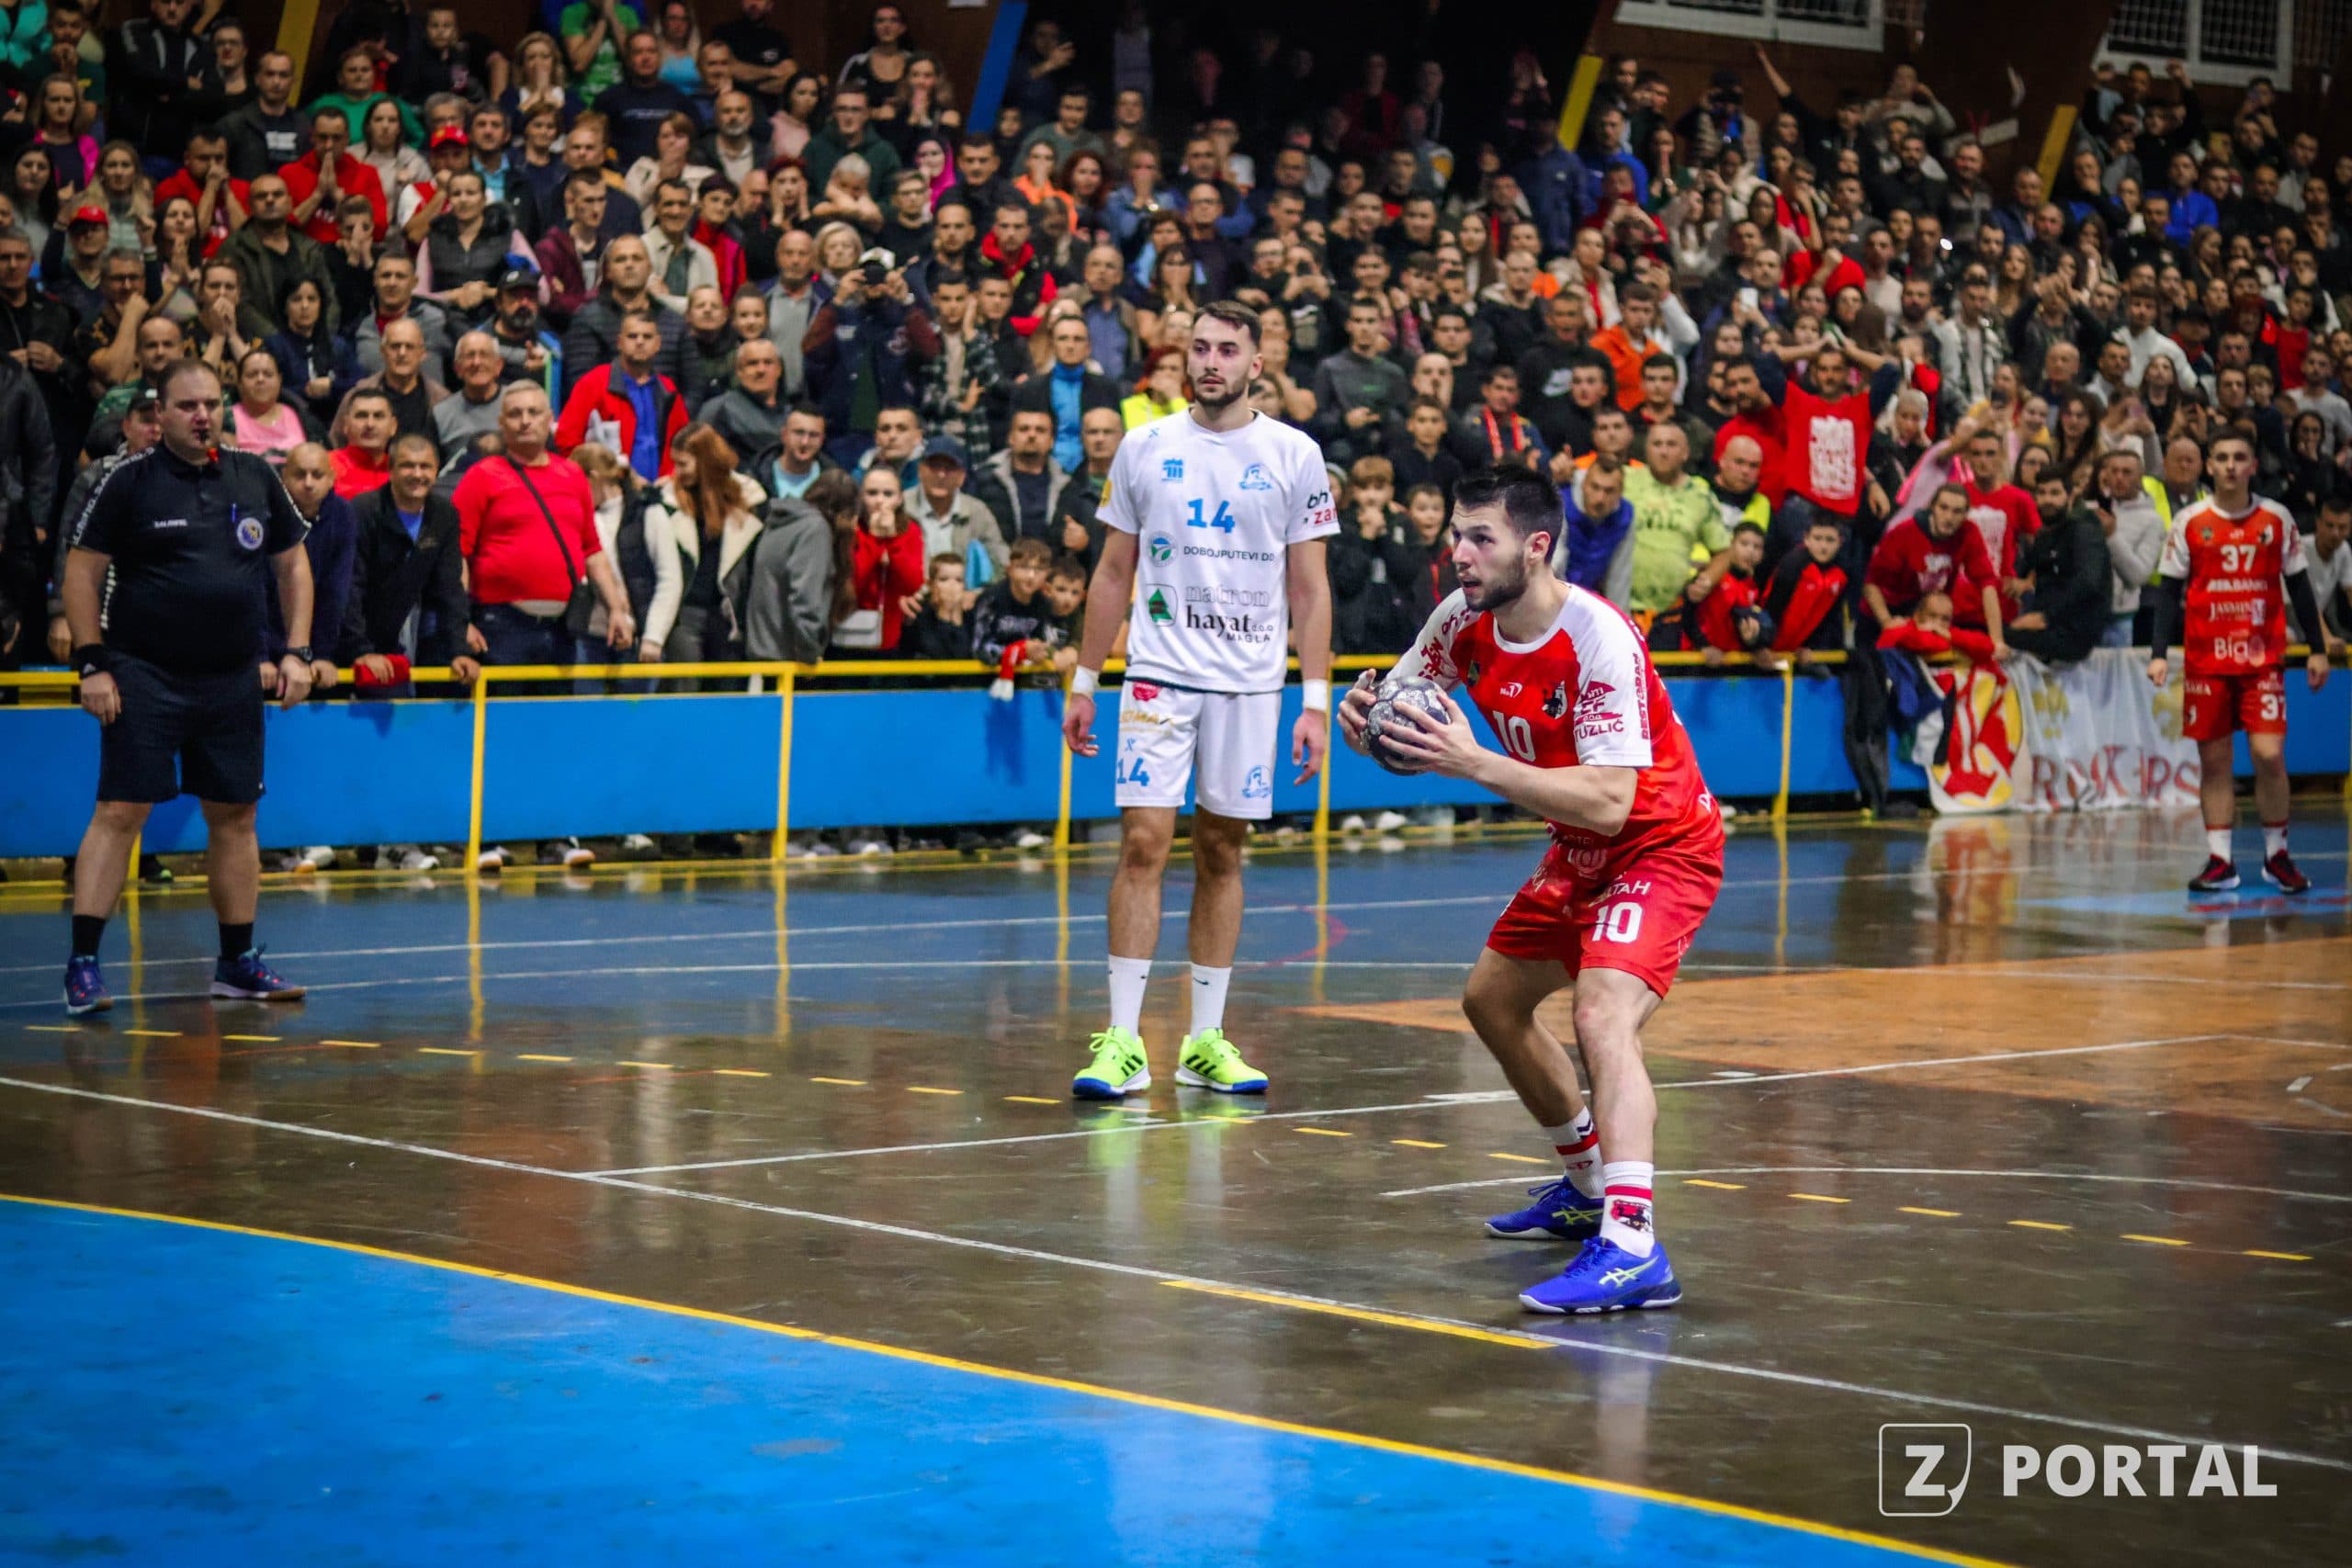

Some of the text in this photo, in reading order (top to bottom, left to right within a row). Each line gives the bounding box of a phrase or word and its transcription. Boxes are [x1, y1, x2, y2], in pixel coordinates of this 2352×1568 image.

[1187, 498, 1236, 534] 14
[1183, 546, 1259, 561] DOBOJPUTEVI
[2220, 544, 2257, 572] 37
[1186, 604, 1250, 637] hayat
[1492, 710, 1536, 762] 10
[1116, 757, 1150, 787] 14
[1591, 901, 1644, 944] 10
